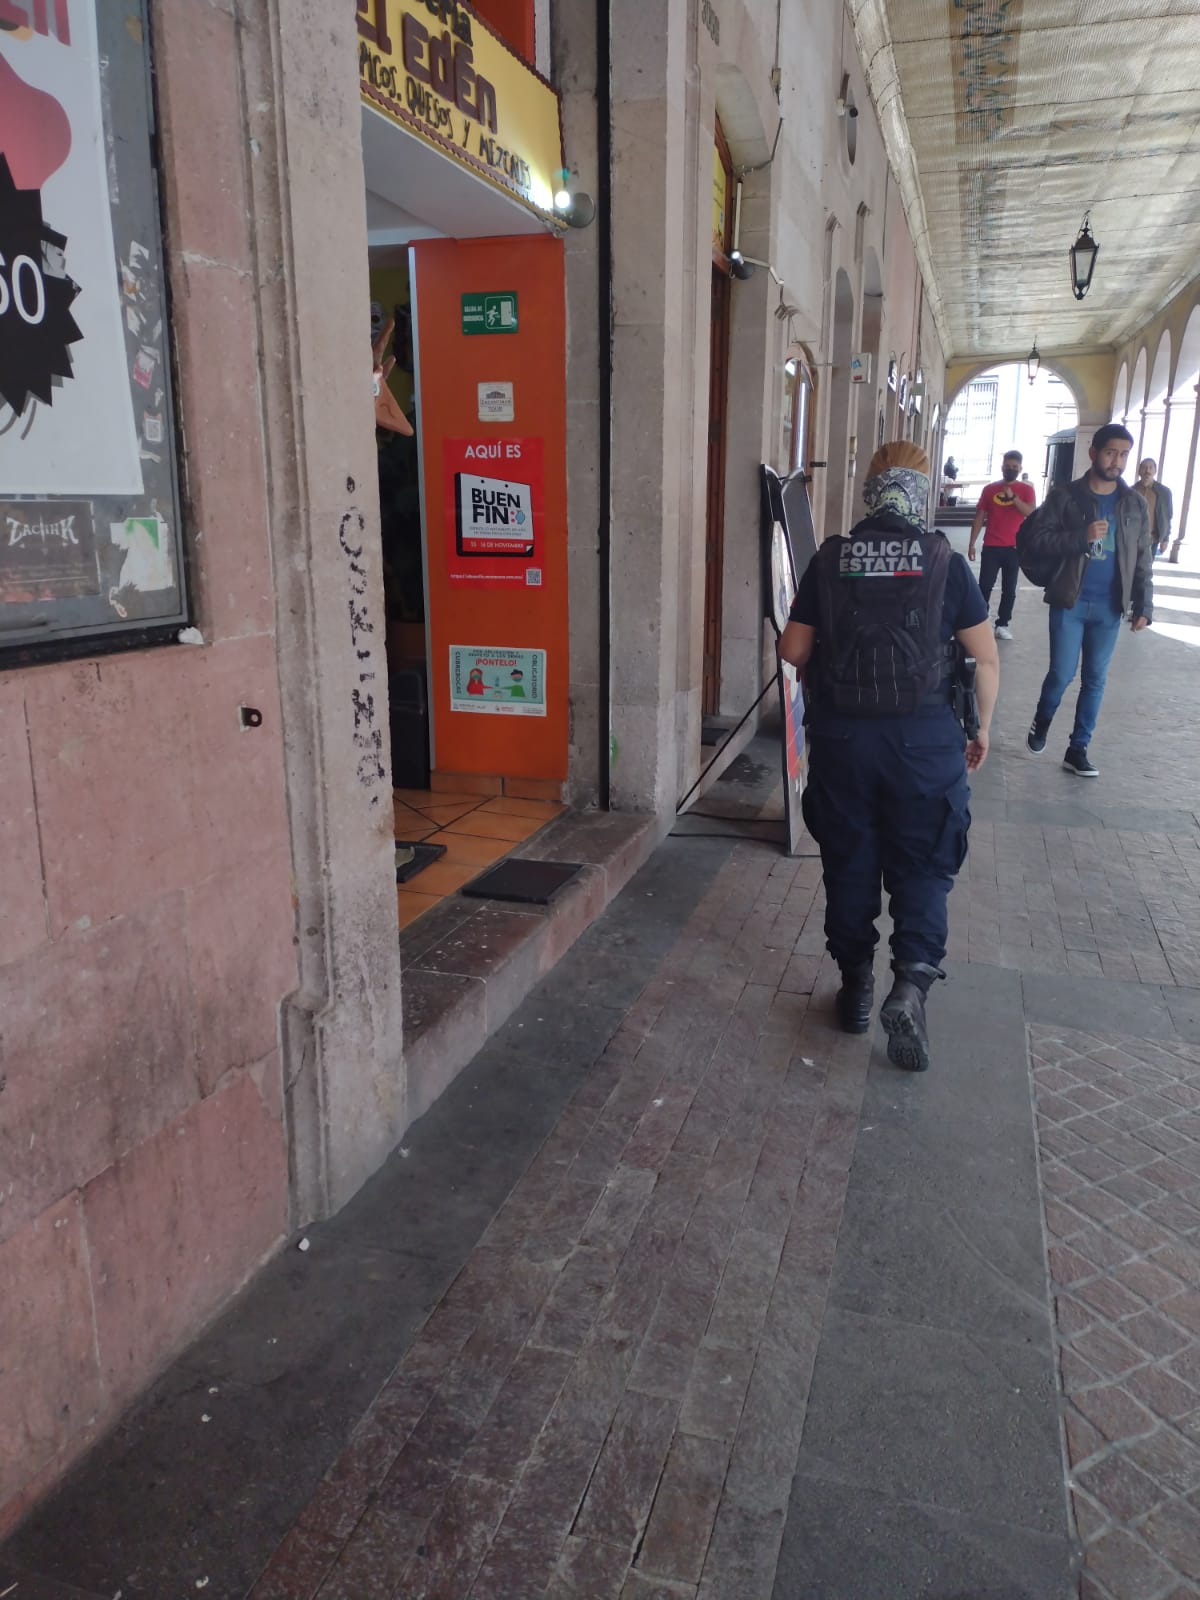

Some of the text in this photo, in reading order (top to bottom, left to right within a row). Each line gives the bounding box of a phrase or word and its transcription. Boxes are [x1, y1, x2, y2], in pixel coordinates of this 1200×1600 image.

[406, 75, 454, 139] QUESOS
[465, 441, 521, 459] AQUÍ ES
[472, 487, 521, 508] BUEN
[840, 539, 923, 557] POLICÍA
[840, 557, 923, 573] ESTATAL
